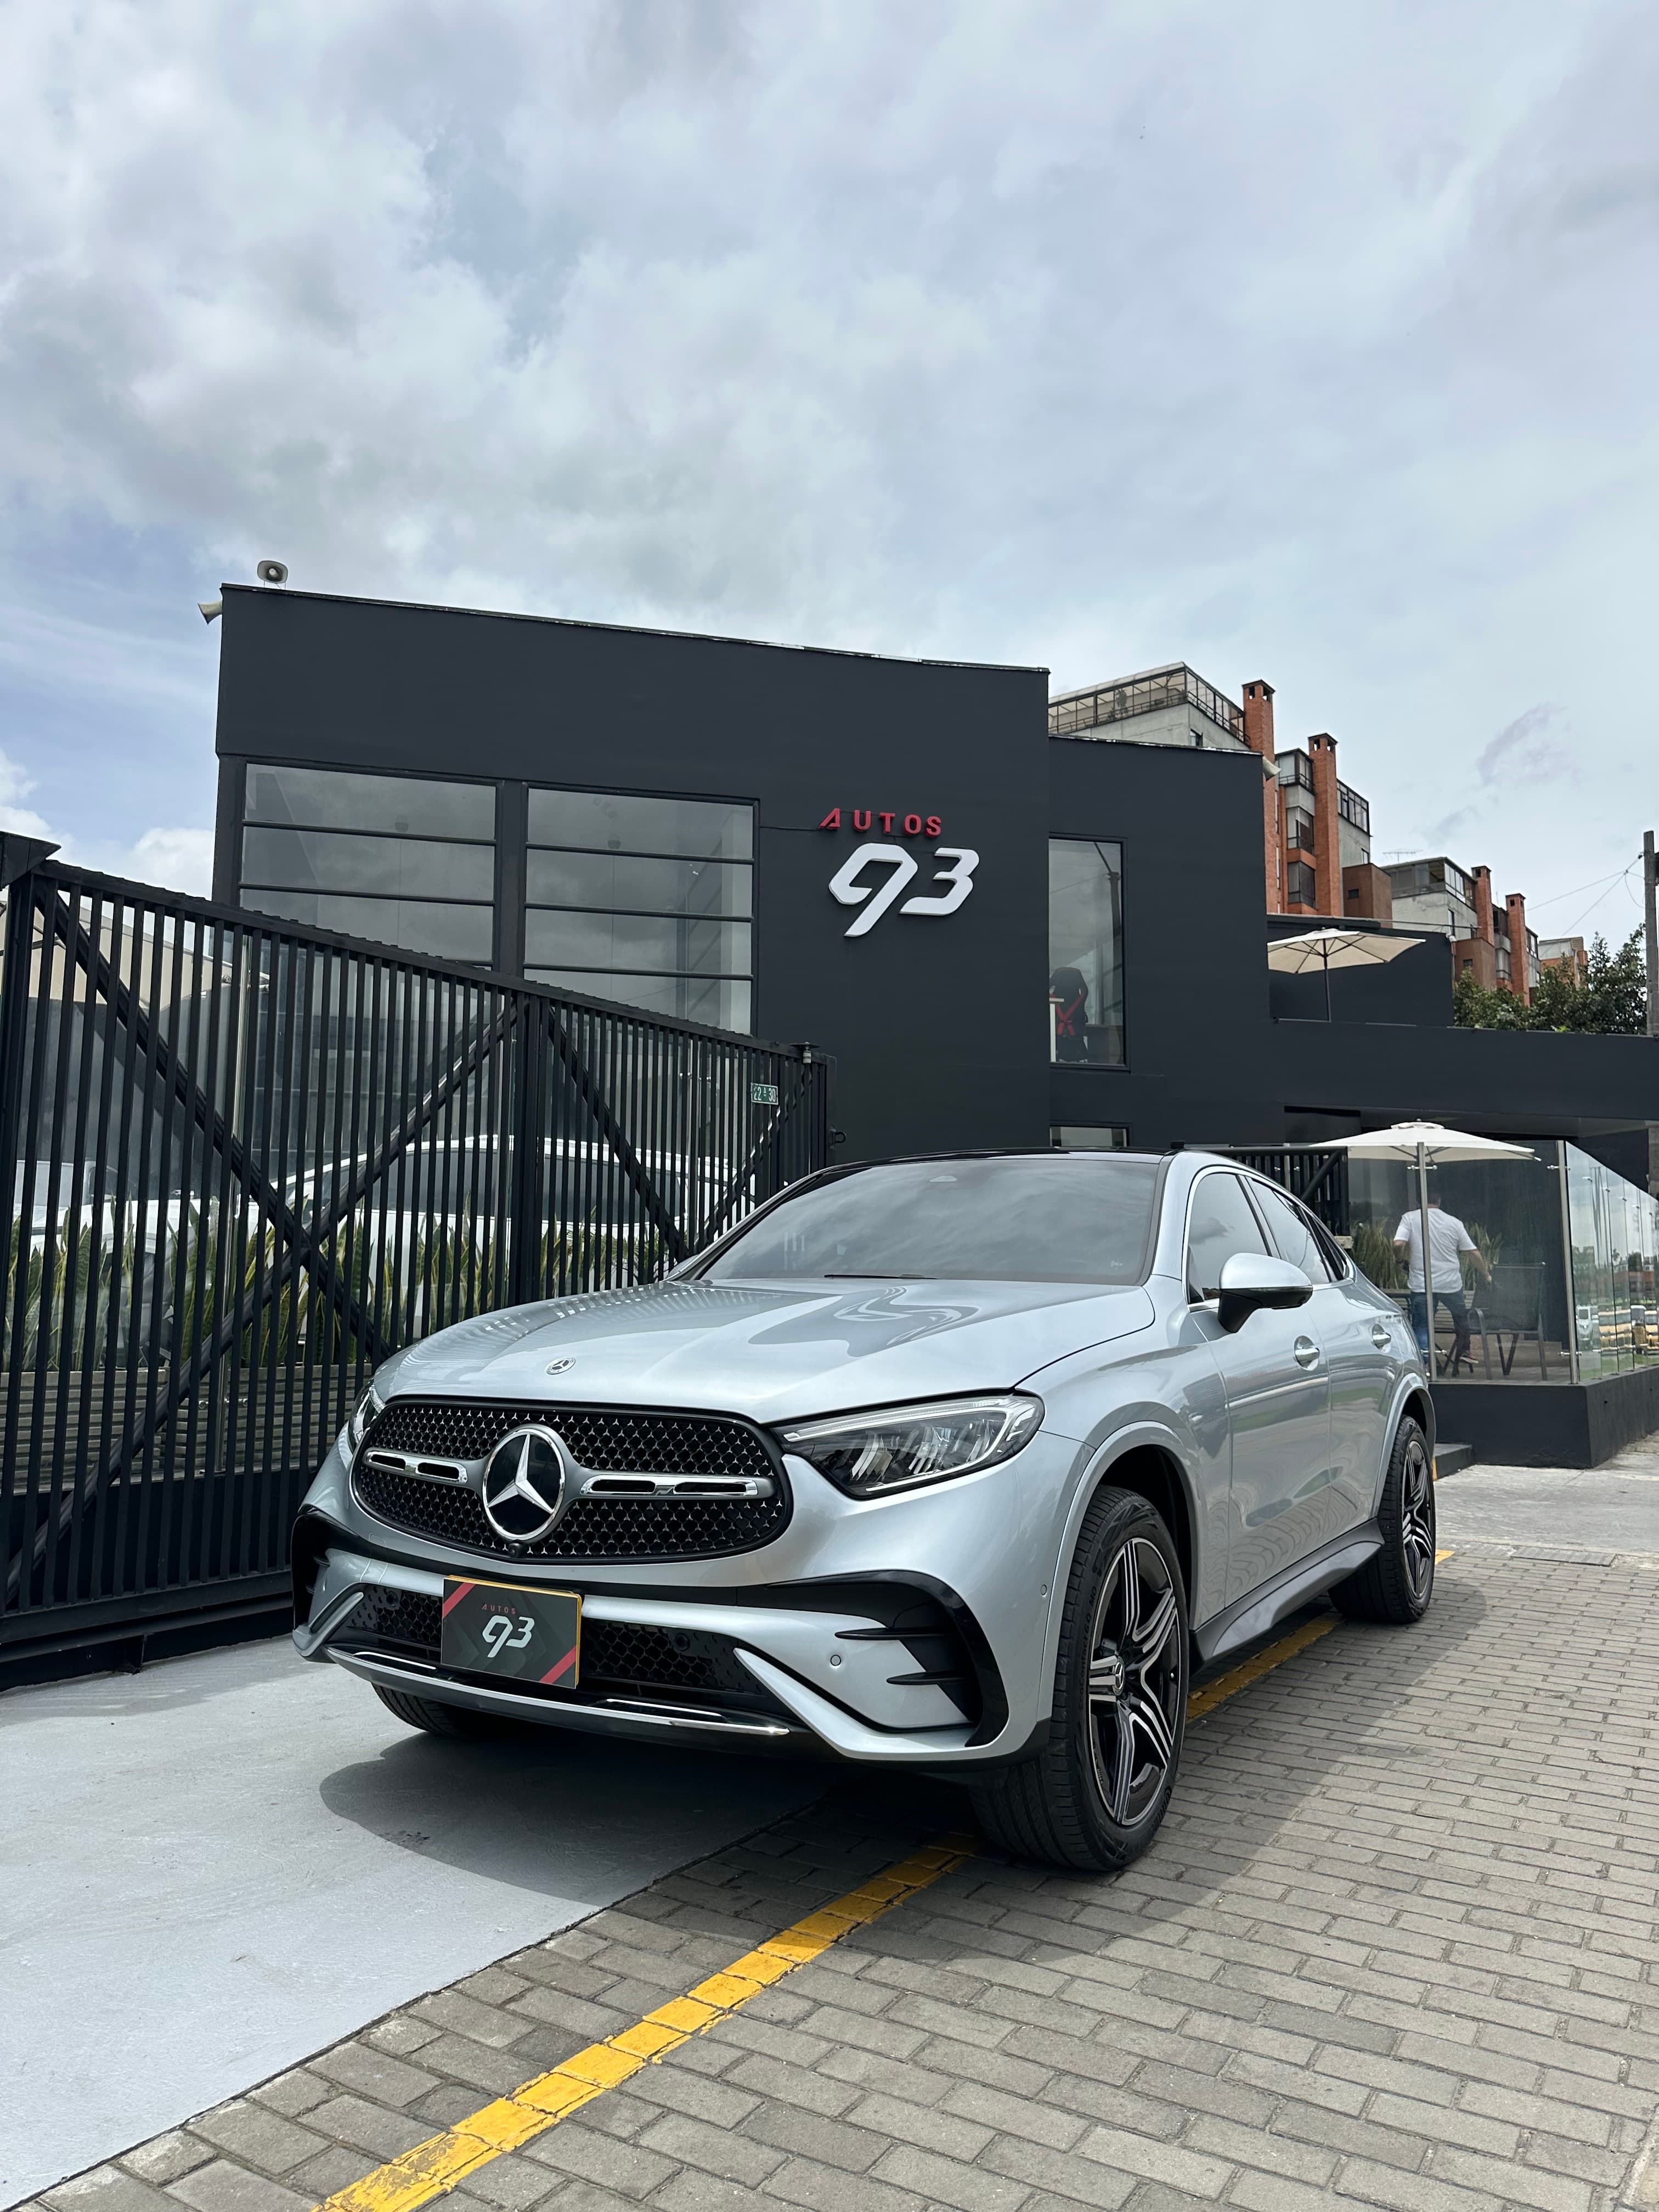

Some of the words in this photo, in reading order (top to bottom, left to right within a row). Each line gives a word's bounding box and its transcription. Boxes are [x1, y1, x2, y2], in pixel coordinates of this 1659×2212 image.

[819, 808, 941, 838] AUTOS
[828, 843, 980, 937] 93
[769, 1088, 776, 1102] 30
[482, 1603, 517, 1615] AUTOS
[482, 1615, 535, 1658] 93
